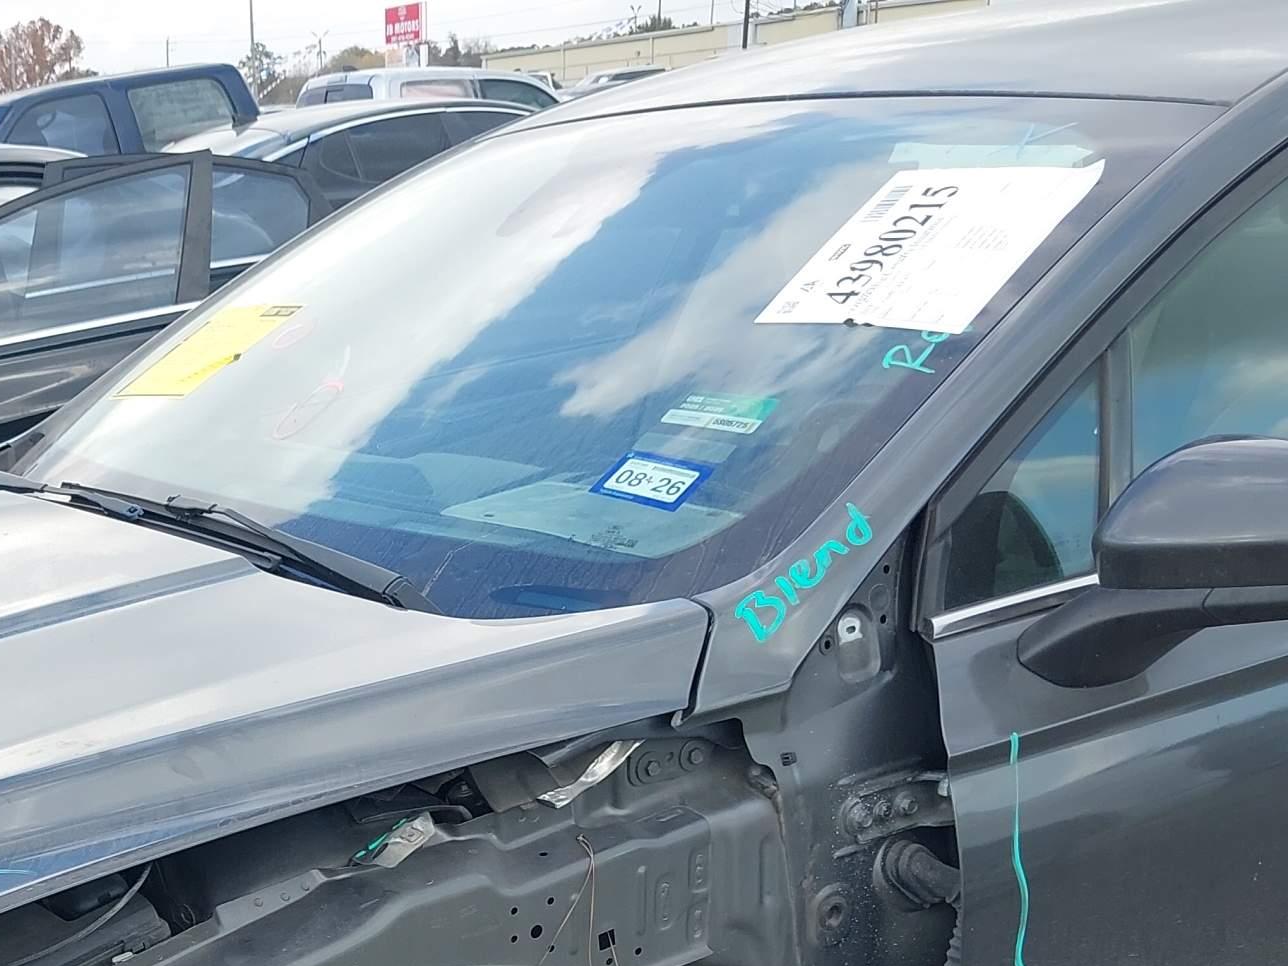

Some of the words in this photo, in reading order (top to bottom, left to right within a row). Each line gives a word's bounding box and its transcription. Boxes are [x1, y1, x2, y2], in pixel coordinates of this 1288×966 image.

[828, 185, 959, 304] 43980215
[615, 469, 648, 487] 08
[650, 477, 686, 496] 26
[735, 502, 873, 641] Blend
